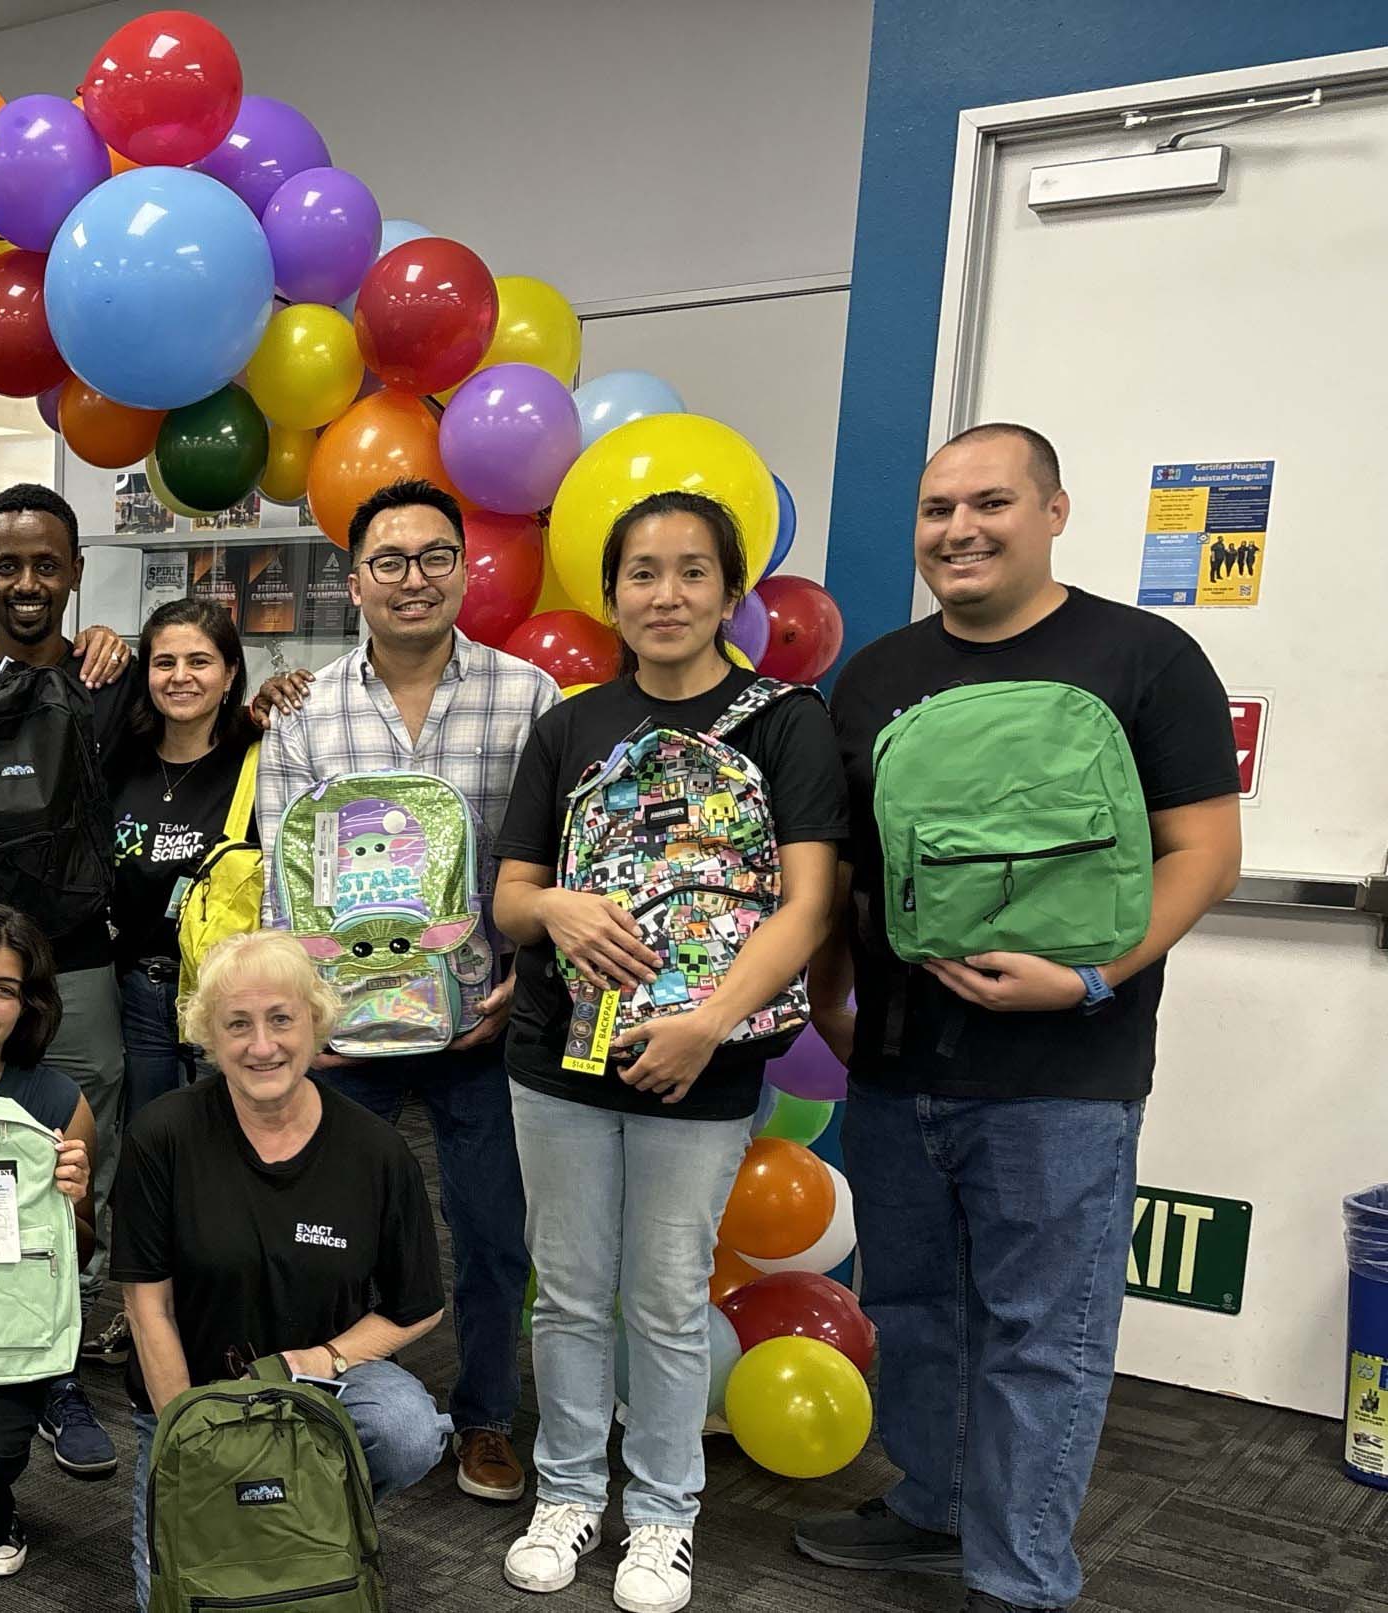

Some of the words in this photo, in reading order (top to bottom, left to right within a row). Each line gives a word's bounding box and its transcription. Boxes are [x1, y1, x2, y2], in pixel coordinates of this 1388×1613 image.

[1194, 463, 1232, 471] Certified
[1233, 462, 1267, 471] Nursing
[1191, 474, 1230, 482] Assistant
[1231, 473, 1268, 482] Program
[148, 566, 184, 580] SPIRIT
[251, 592, 293, 600] CHAMPIONS
[158, 822, 190, 833] TEAM
[153, 831, 204, 848] EXACT
[150, 844, 205, 862] SCIENC
[338, 867, 420, 894] STAR
[598, 993, 615, 1039] BACKPACK
[296, 1222, 333, 1237] EXACT
[294, 1232, 348, 1249] SCIENCES
[239, 1494, 264, 1502] ARCTIC
